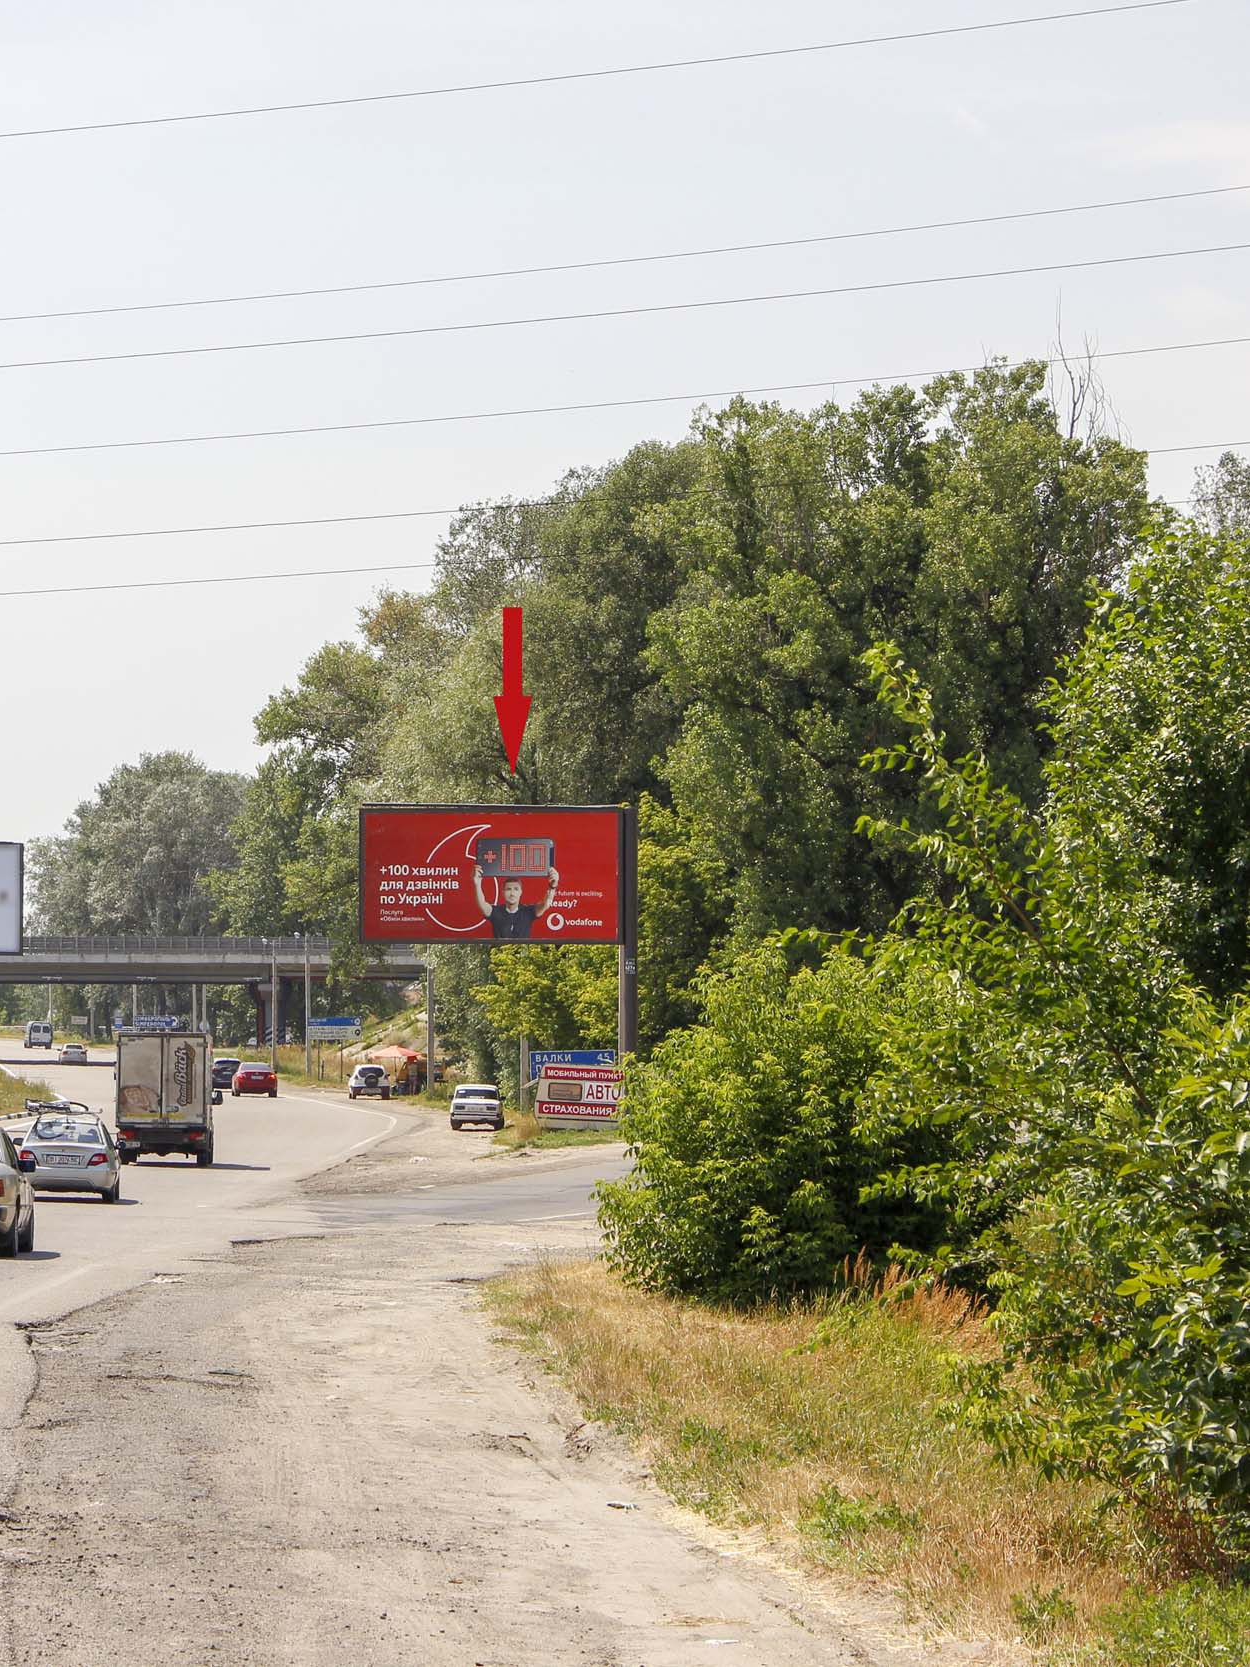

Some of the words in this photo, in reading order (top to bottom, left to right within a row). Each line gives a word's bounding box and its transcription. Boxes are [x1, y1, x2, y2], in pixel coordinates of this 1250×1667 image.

[379, 864, 409, 876] +100
[412, 866, 458, 876] хвилин
[379, 880, 403, 891] для
[406, 878, 459, 890] дзвінків
[380, 895, 395, 904] по
[398, 893, 443, 906] Україні
[565, 918, 603, 926] vodafone
[535, 1054, 572, 1063] ВАЛКИ
[547, 1070, 597, 1078] МОБИЛЬНЫЙ
[598, 1072, 622, 1080] ПУНКТ
[586, 1084, 622, 1100] АВТО
[542, 1104, 613, 1115] СТРАХОВАНИЯ
